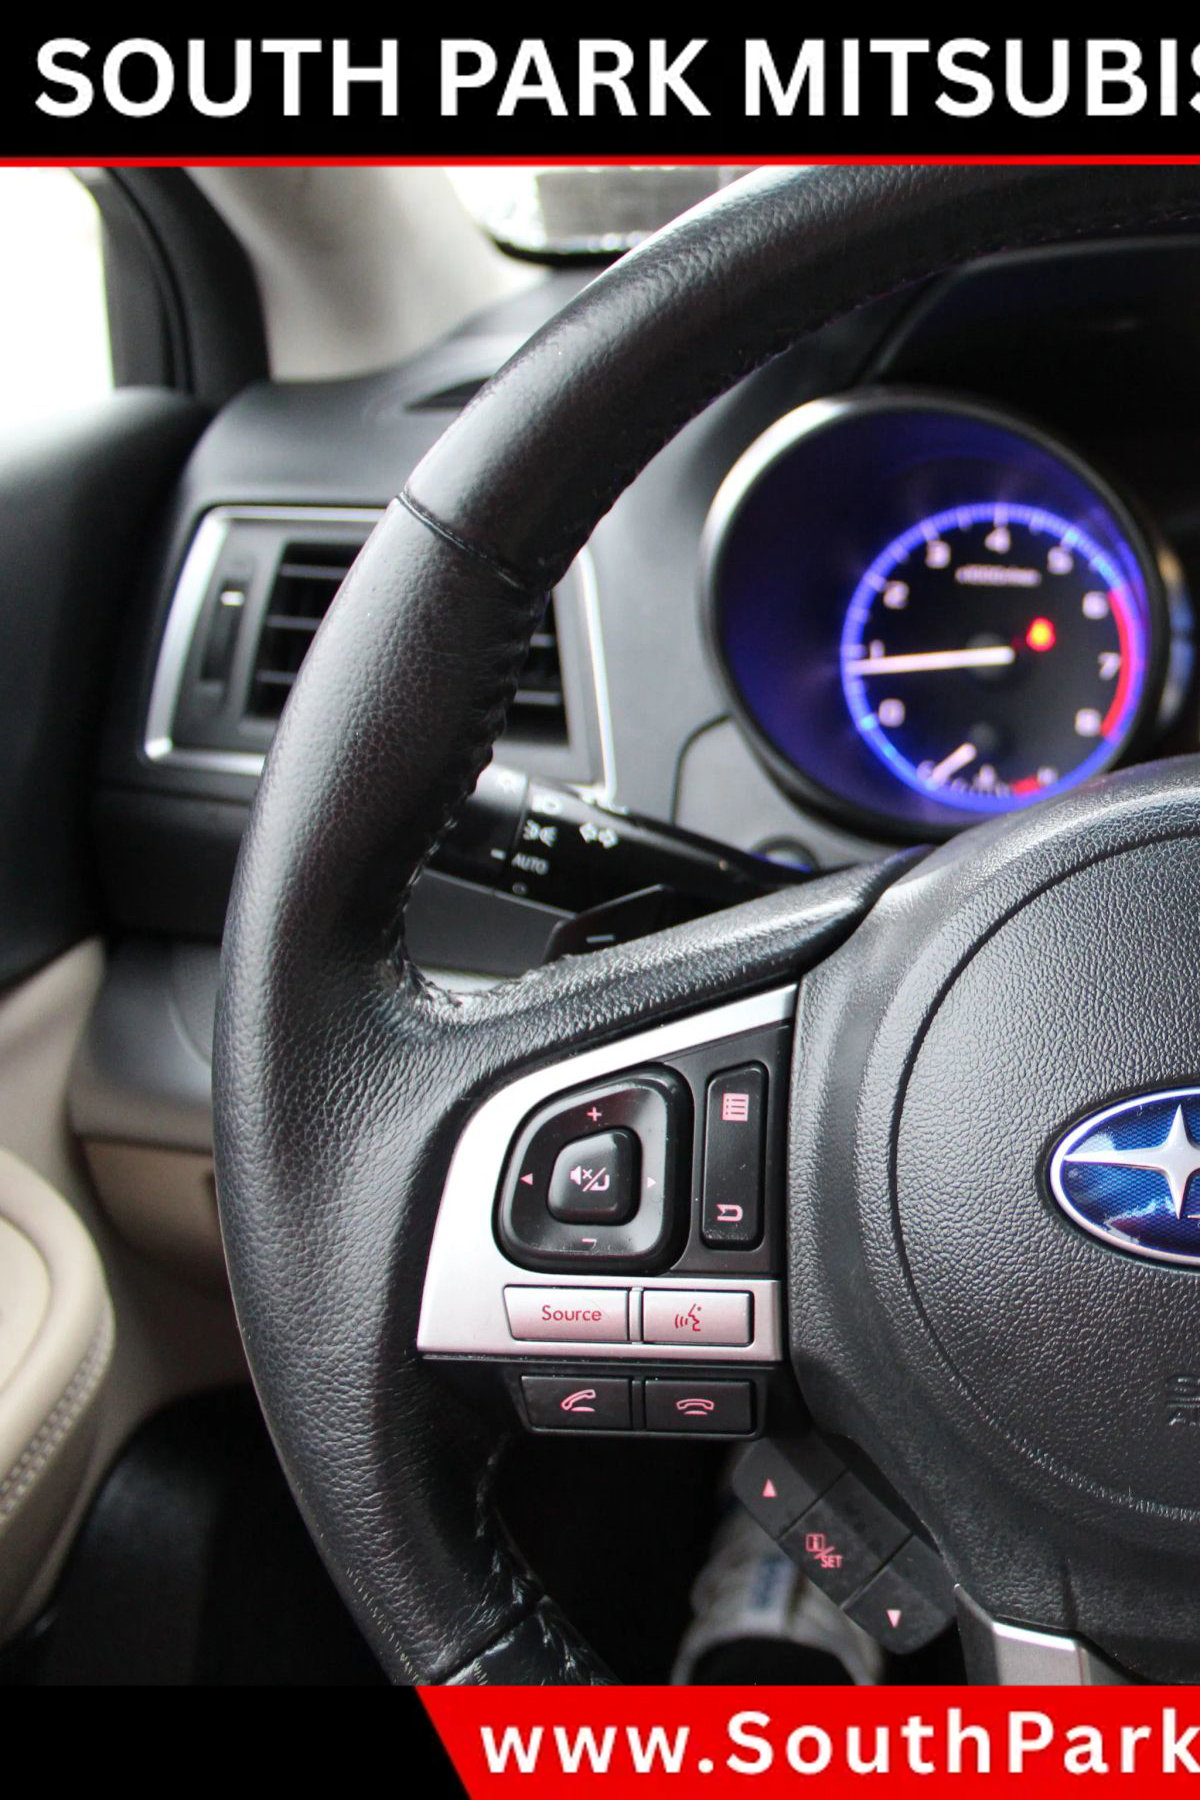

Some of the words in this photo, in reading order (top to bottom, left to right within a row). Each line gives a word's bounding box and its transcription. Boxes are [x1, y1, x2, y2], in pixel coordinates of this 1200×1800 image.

[511, 853, 549, 875] AUTO
[541, 1304, 602, 1322] Source
[820, 1554, 843, 1569] SET
